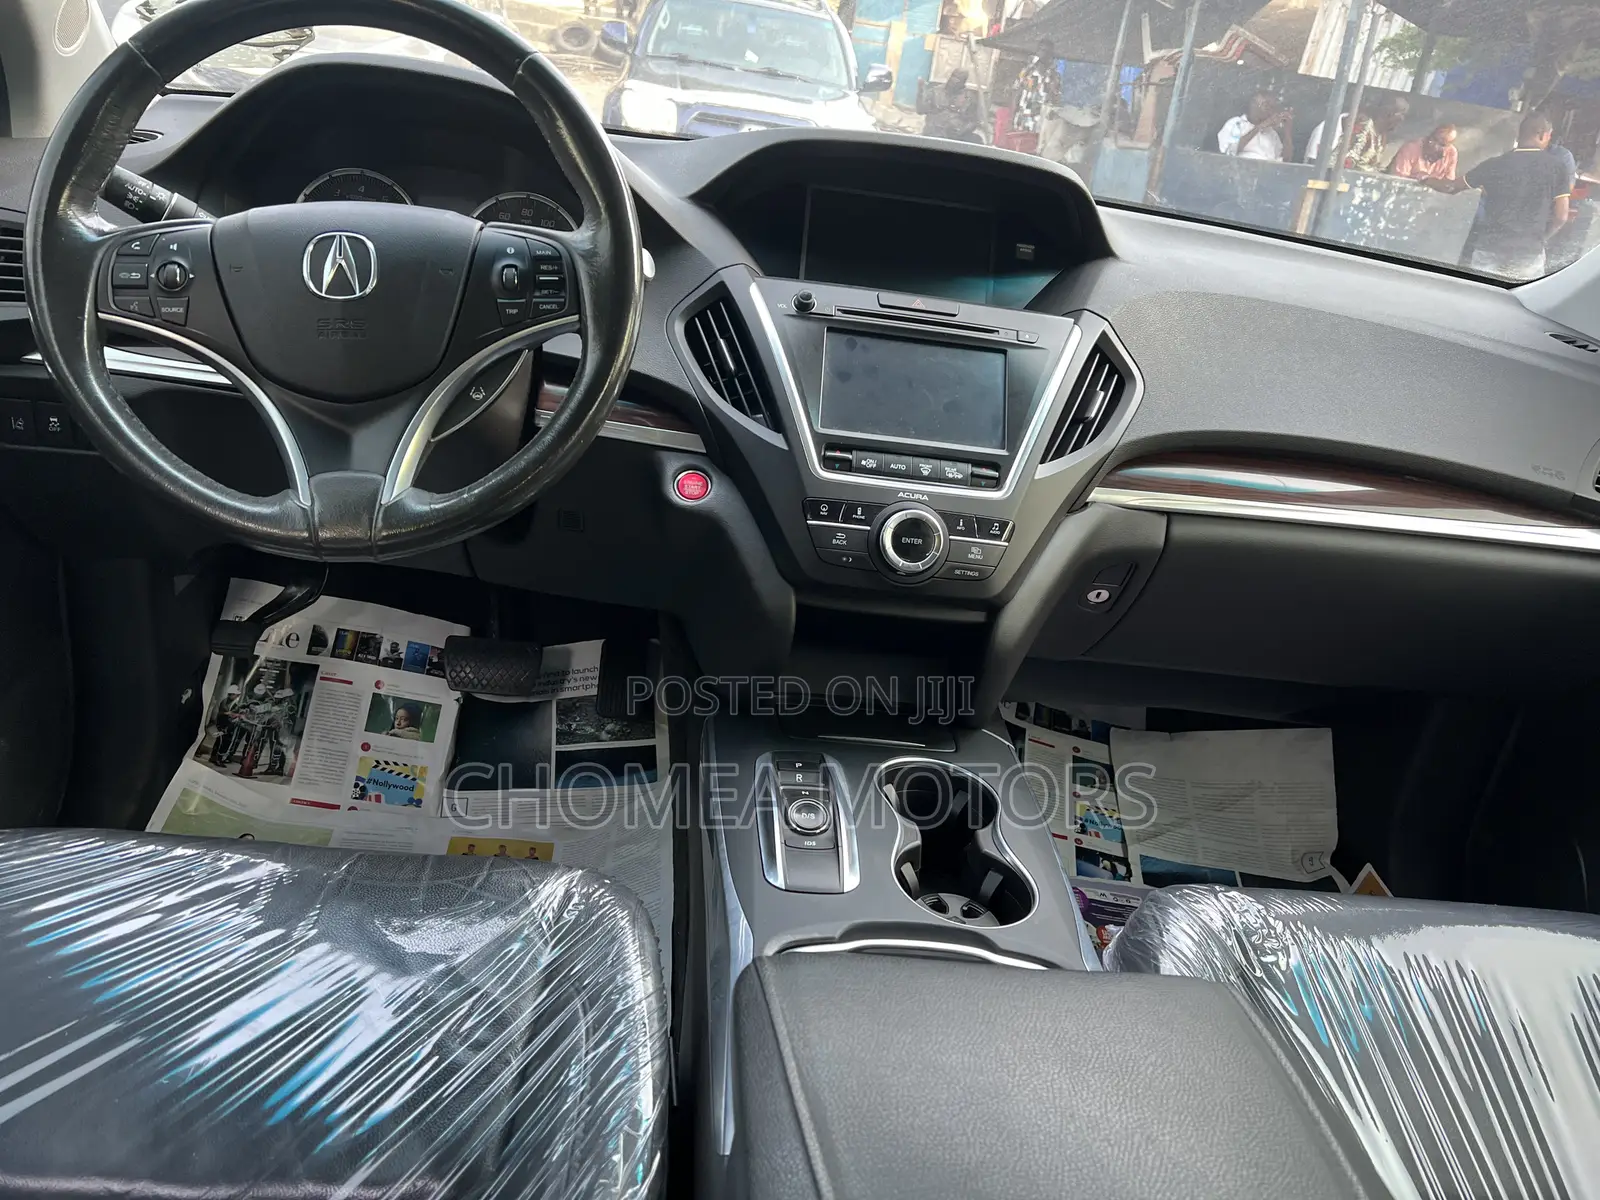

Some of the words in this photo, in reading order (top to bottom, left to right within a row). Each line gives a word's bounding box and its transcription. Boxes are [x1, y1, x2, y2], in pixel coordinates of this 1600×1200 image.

[358, 185, 365, 193] 4
[498, 212, 511, 221] 60
[521, 208, 534, 217] 80
[540, 219, 556, 228] 100
[890, 463, 906, 471] AUTO
[898, 491, 929, 501] ACURA
[832, 538, 847, 546] BACK
[901, 537, 923, 545] ENTER
[954, 569, 980, 577] SETTINGS
[572, 666, 599, 675] launch
[796, 773, 803, 783] R
[366, 777, 415, 793] #Nollywood
[801, 812, 816, 820] D/S
